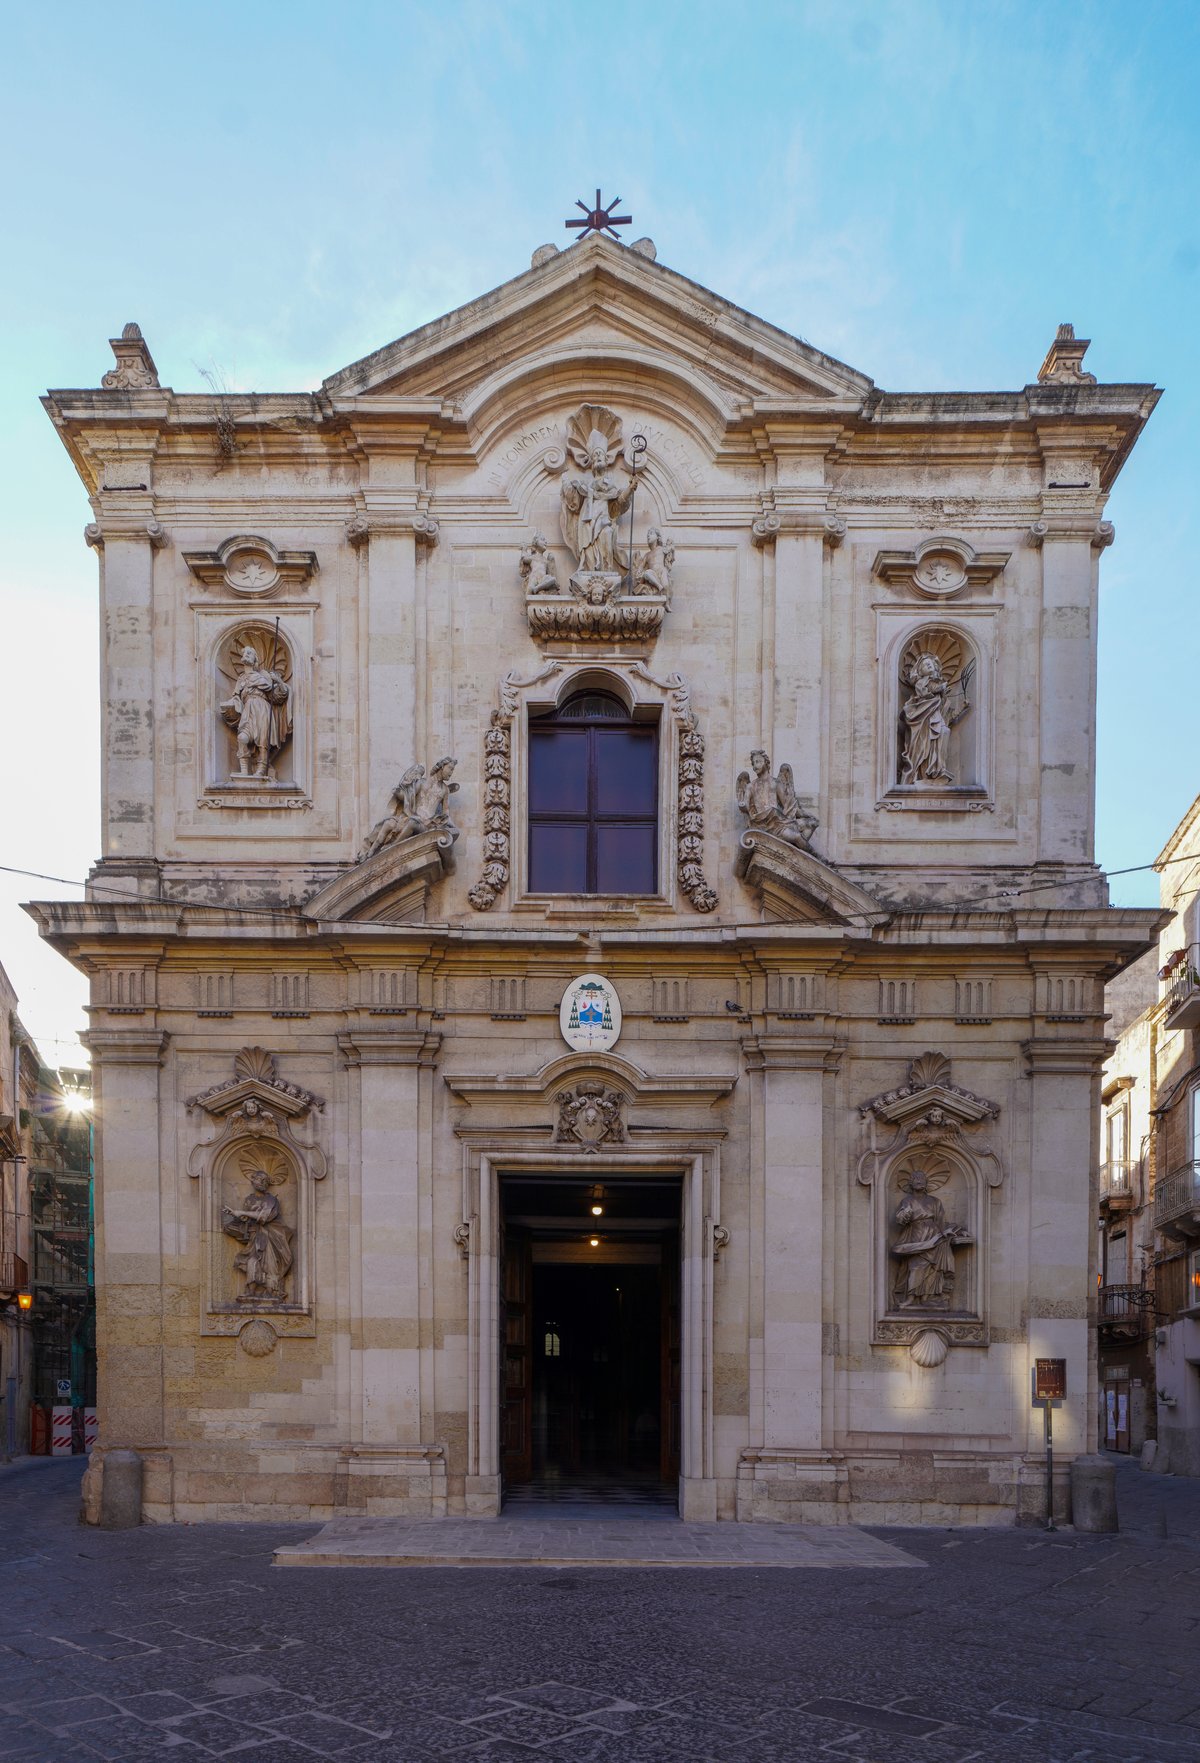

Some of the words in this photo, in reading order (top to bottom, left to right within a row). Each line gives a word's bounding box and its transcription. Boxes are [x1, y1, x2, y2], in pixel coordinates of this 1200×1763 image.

[487, 471, 502, 488] IN
[497, 423, 560, 471] HONOREM
[632, 422, 664, 444] DIVI
